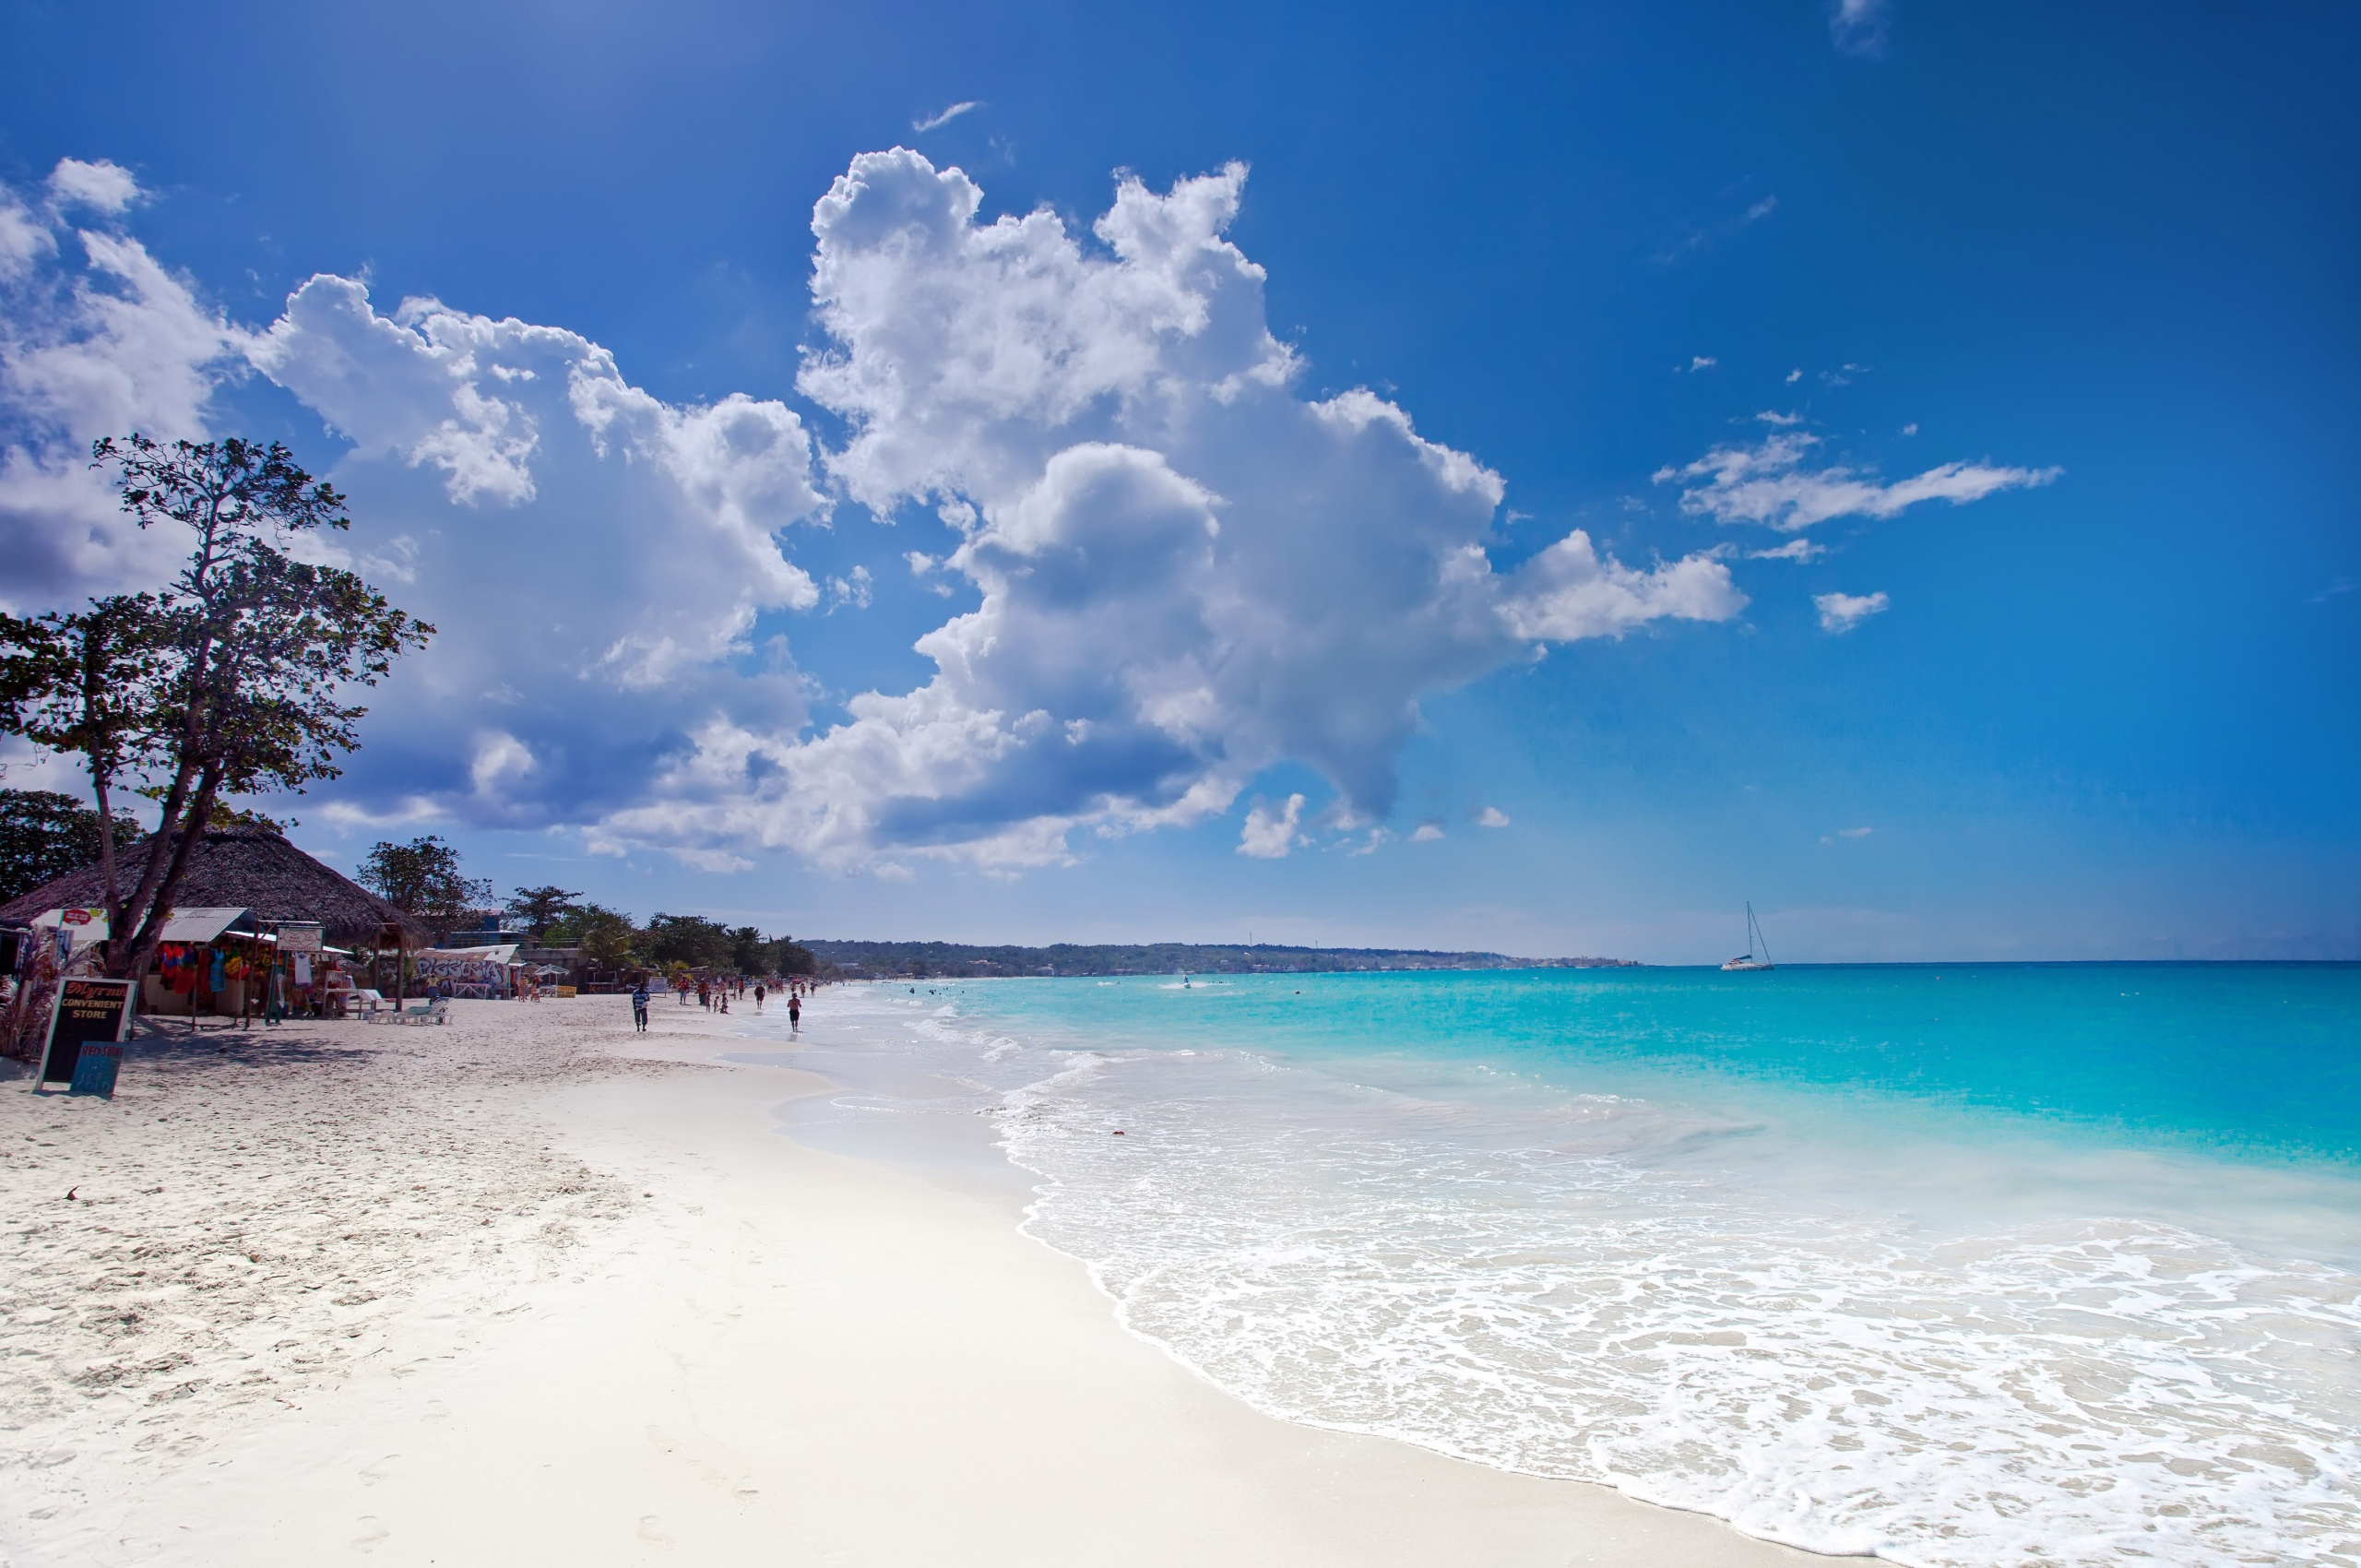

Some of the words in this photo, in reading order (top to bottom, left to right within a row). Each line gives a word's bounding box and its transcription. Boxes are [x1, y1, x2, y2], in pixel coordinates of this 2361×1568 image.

[61, 998, 124, 1010] CONVENIENT
[72, 1009, 108, 1019] STORE
[81, 1046, 101, 1056] RED
